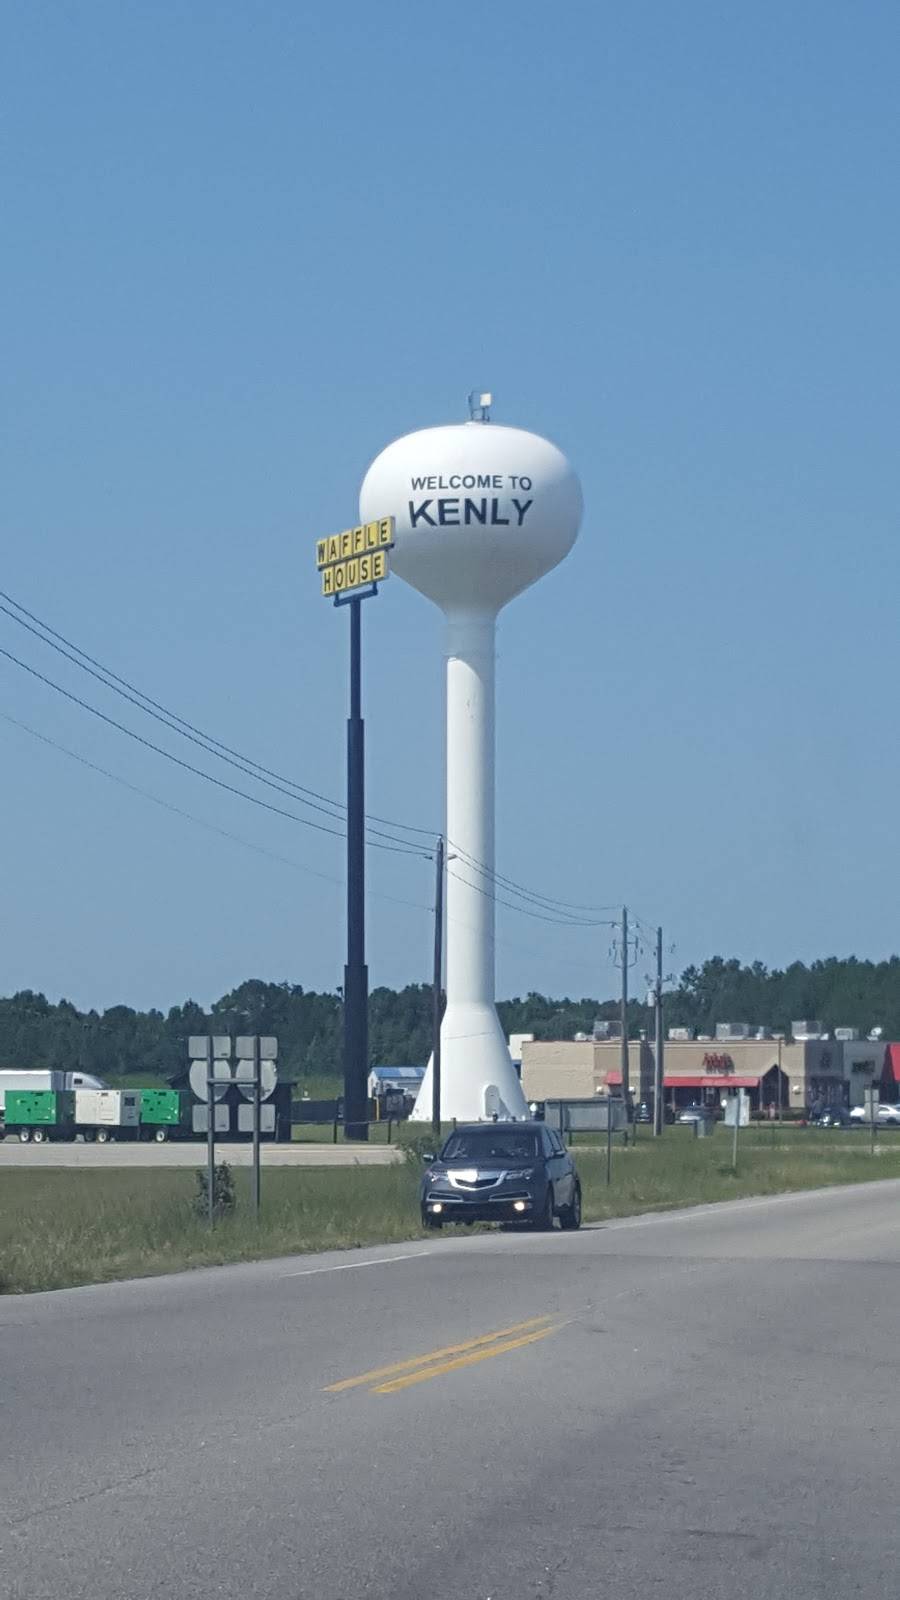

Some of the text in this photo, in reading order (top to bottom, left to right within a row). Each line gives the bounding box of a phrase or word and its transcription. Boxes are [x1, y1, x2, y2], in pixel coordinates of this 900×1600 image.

[411, 475, 533, 491] WELCOME TO
[408, 498, 533, 528] KENLY
[317, 521, 388, 563] WAFFLE
[323, 555, 382, 593] HOUSE
